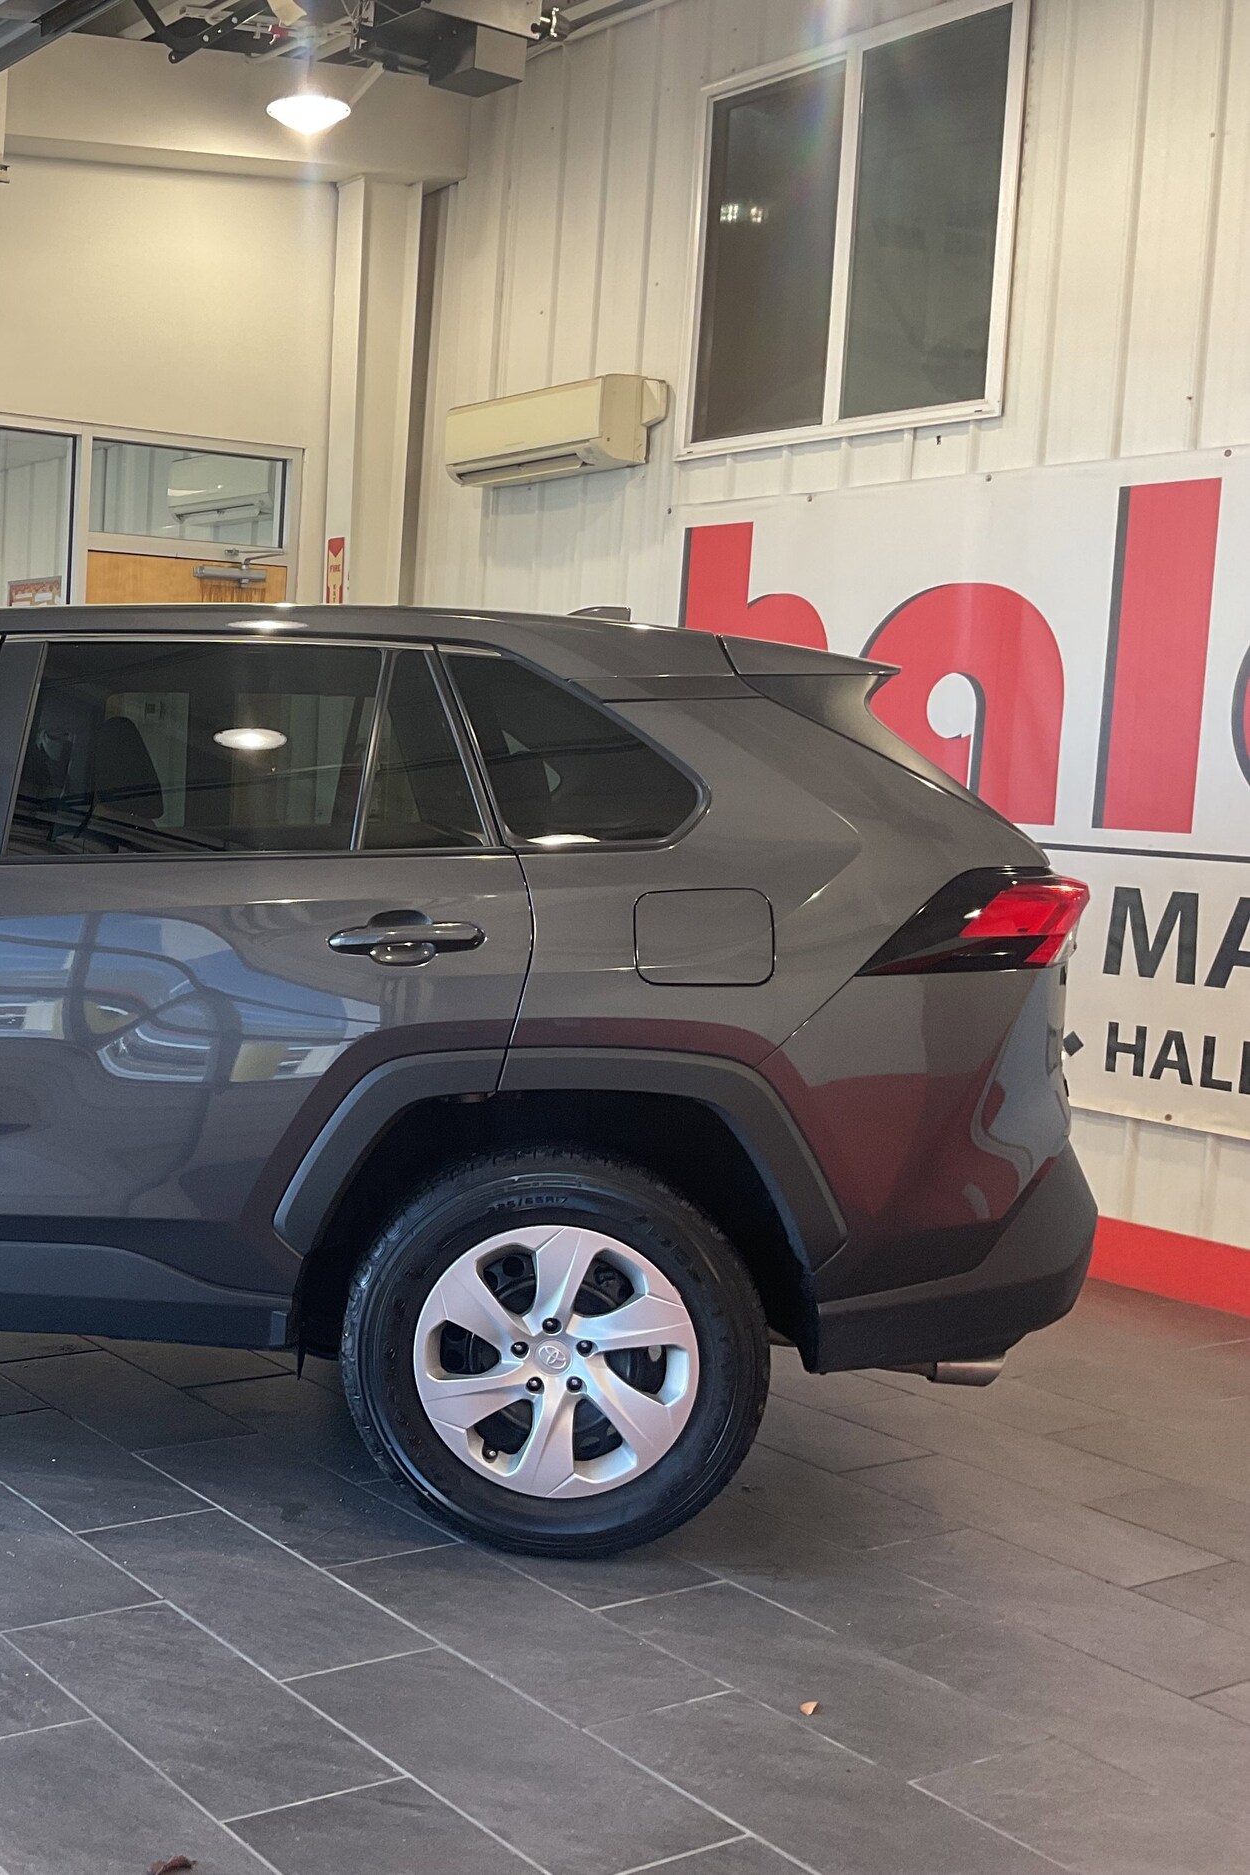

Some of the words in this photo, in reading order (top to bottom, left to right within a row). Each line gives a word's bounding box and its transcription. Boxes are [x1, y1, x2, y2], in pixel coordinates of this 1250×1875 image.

[330, 564, 341, 572] FIRE
[679, 477, 1250, 834] al
[1104, 1021, 1250, 1095] HAL
